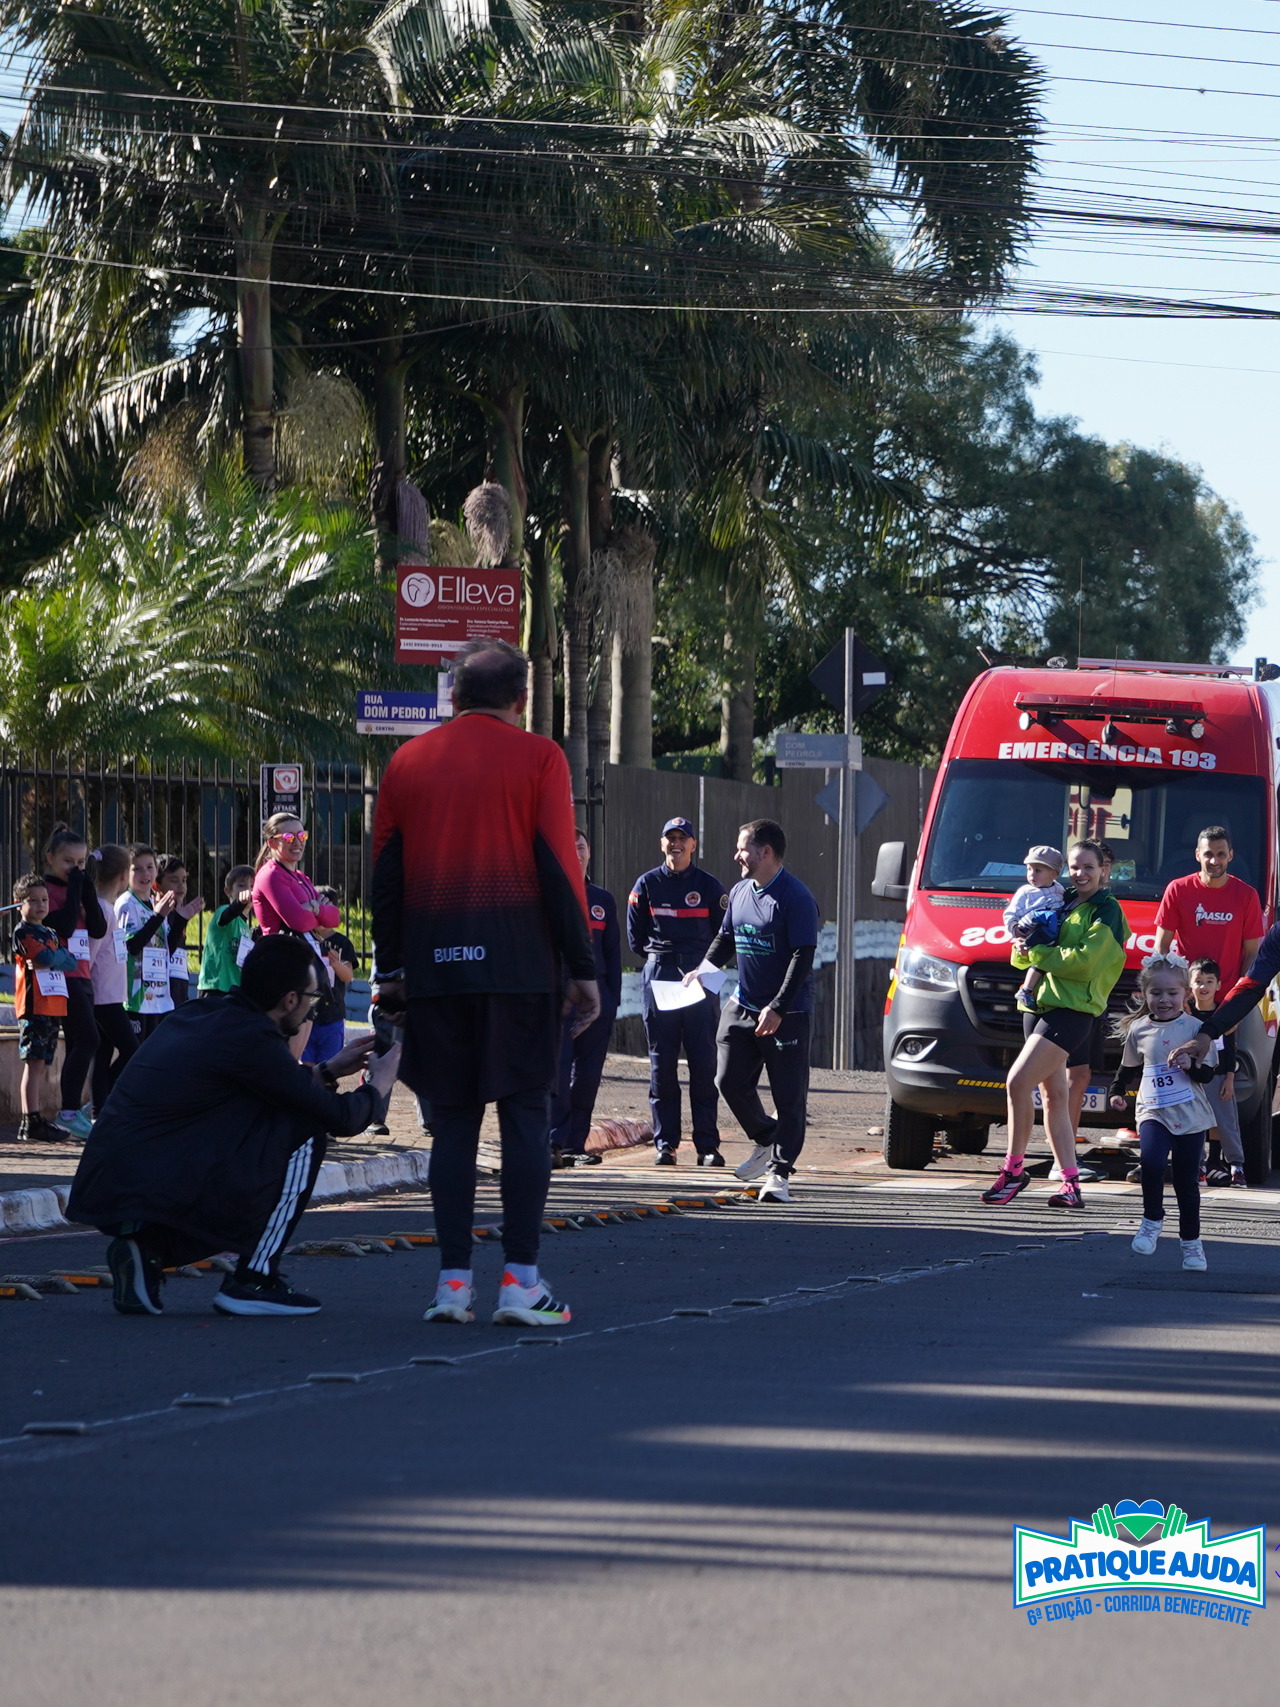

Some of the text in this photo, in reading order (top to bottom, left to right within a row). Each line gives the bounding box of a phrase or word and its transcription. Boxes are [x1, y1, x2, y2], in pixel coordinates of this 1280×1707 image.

[437, 575, 515, 606] Elleva
[364, 694, 383, 705] RUA
[364, 705, 437, 720] DOM PEDRO II
[998, 739, 1217, 770] EMERGÊNCIA 193
[433, 945, 487, 963] BUENO
[1151, 1075, 1174, 1088] 183
